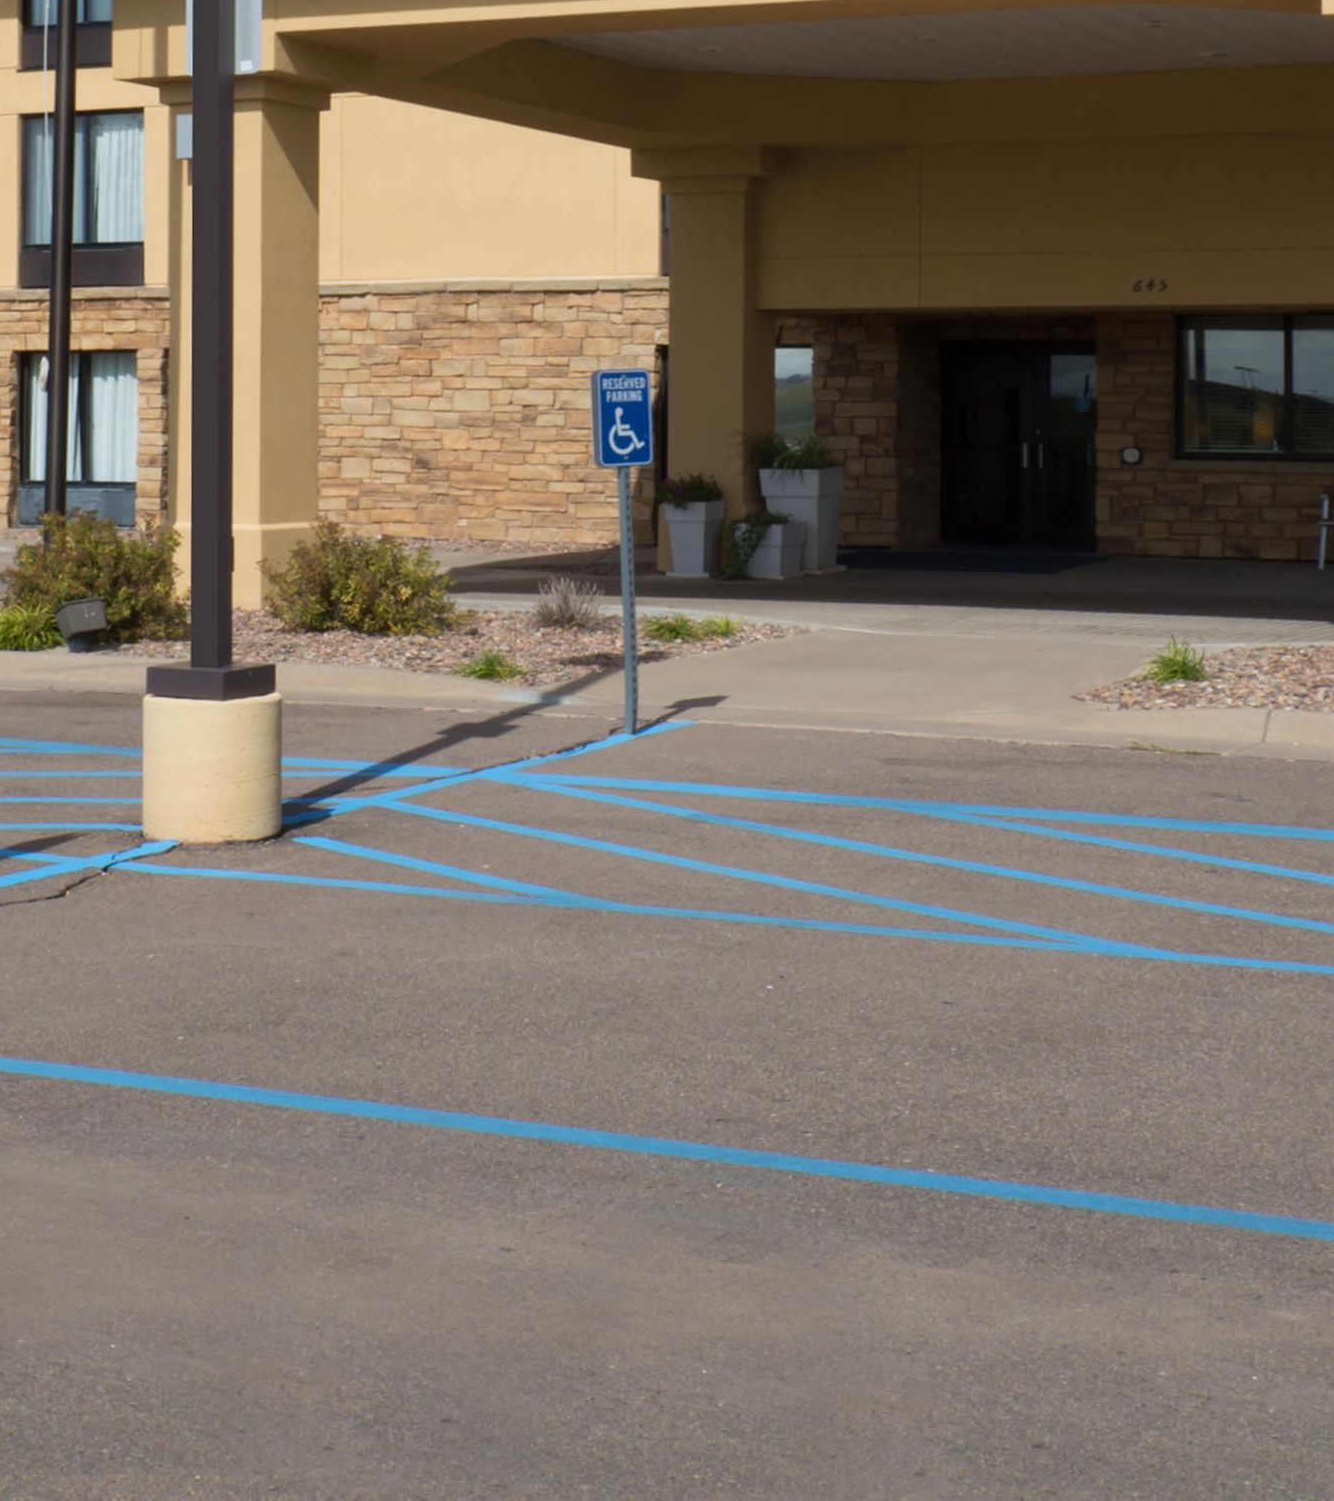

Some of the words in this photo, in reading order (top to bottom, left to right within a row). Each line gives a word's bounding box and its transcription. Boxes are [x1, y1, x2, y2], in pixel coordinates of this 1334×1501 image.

[1132, 279, 1169, 293] 645
[602, 377, 646, 390] RESERVED
[606, 390, 643, 403] PARKING
